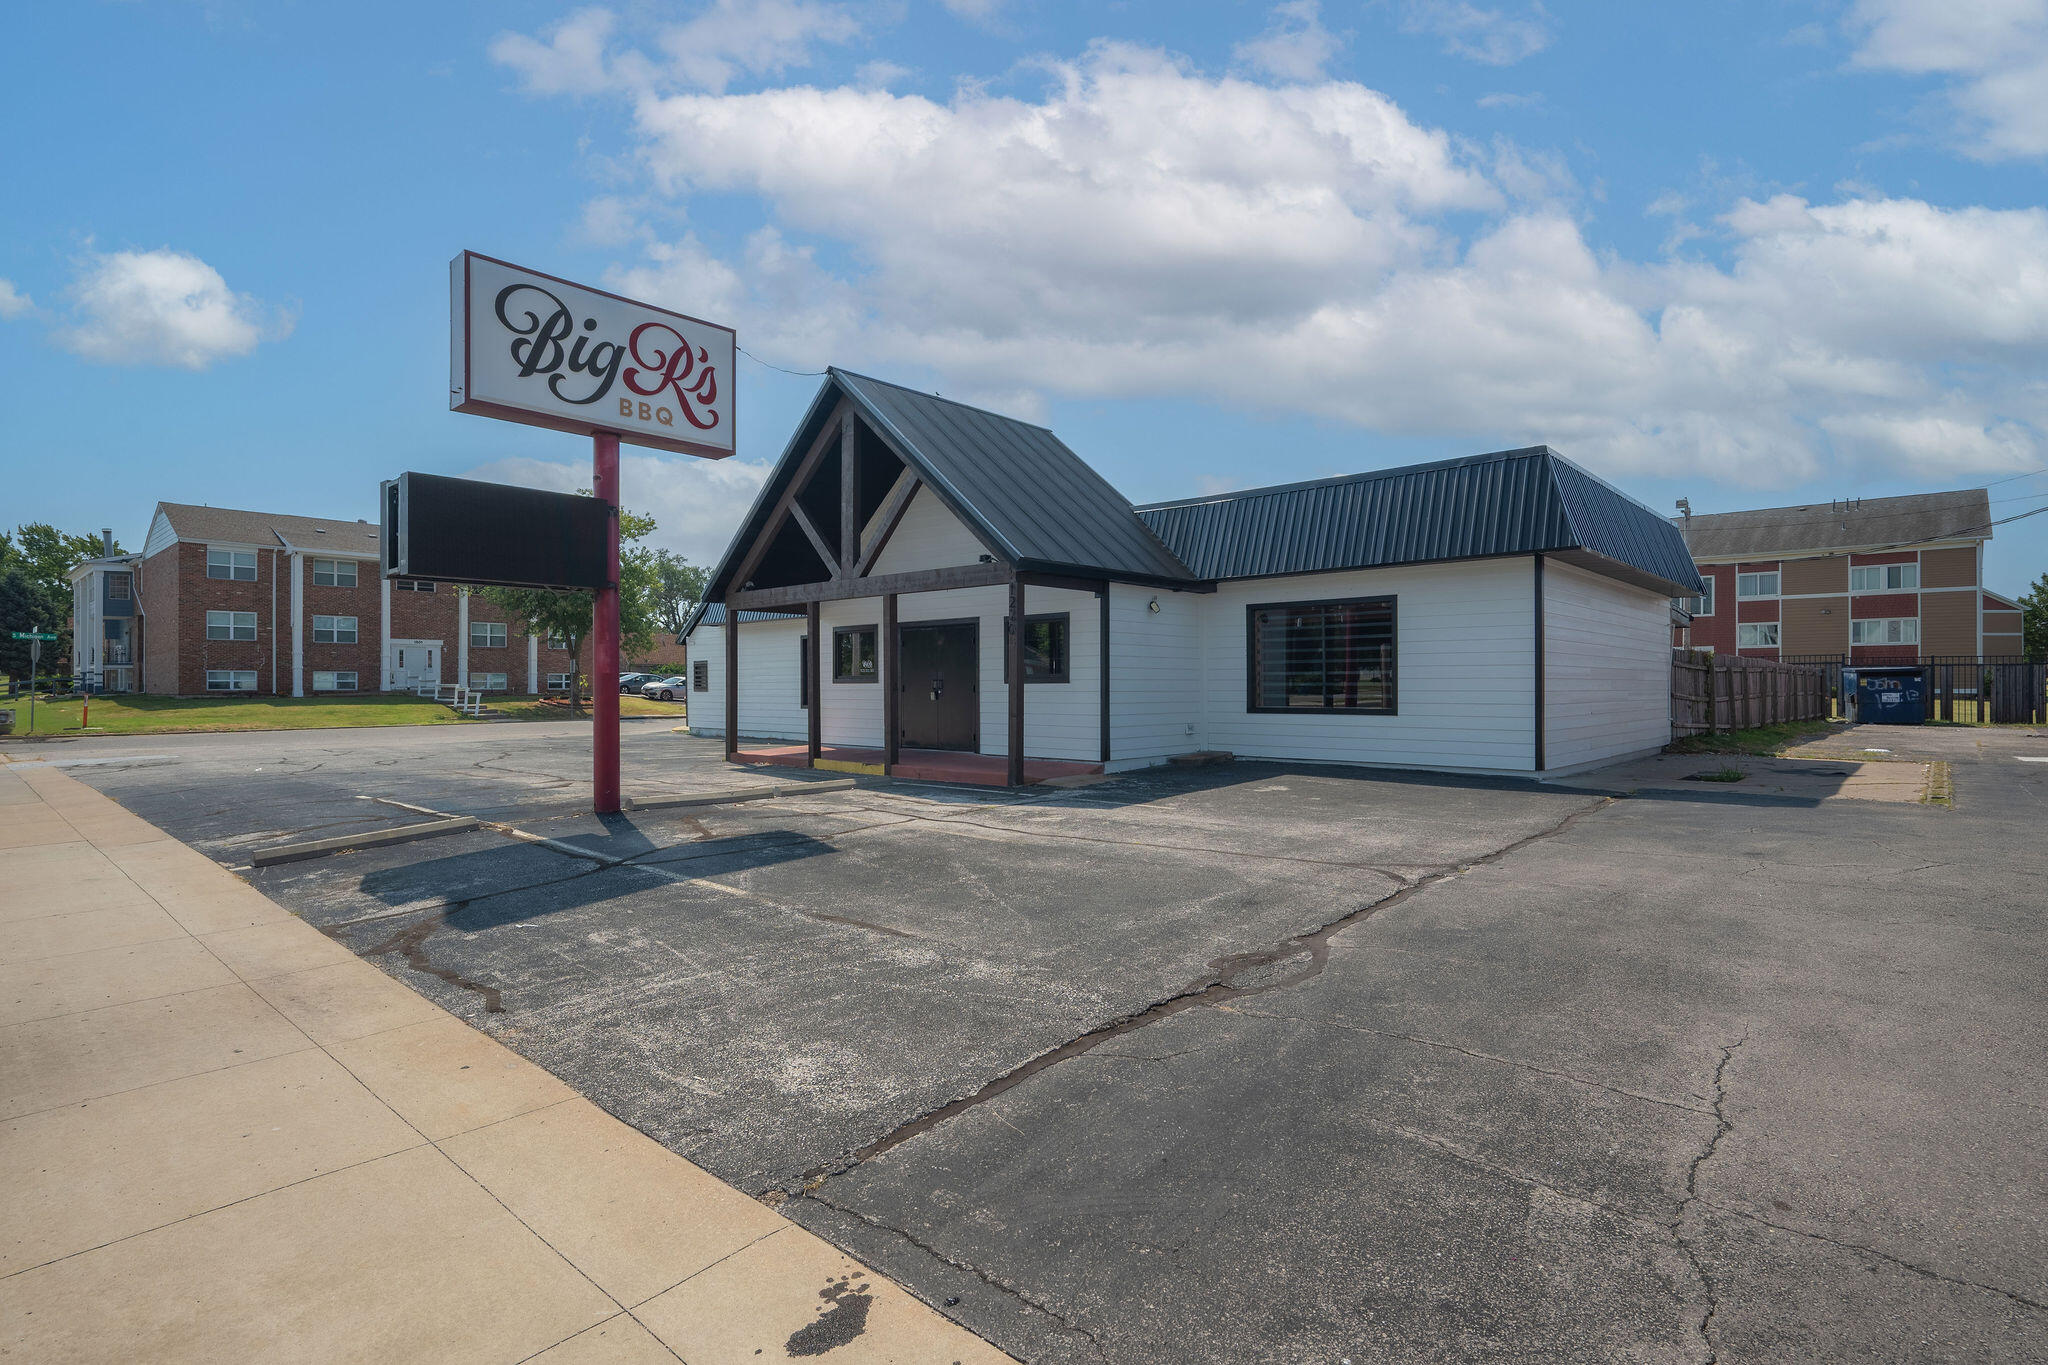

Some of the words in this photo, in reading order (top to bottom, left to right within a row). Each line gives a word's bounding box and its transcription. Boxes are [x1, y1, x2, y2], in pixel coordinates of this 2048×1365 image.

[495, 284, 626, 404] Big
[623, 322, 719, 430] R's
[619, 397, 674, 427] BBQ
[19, 632, 44, 640] Michigan
